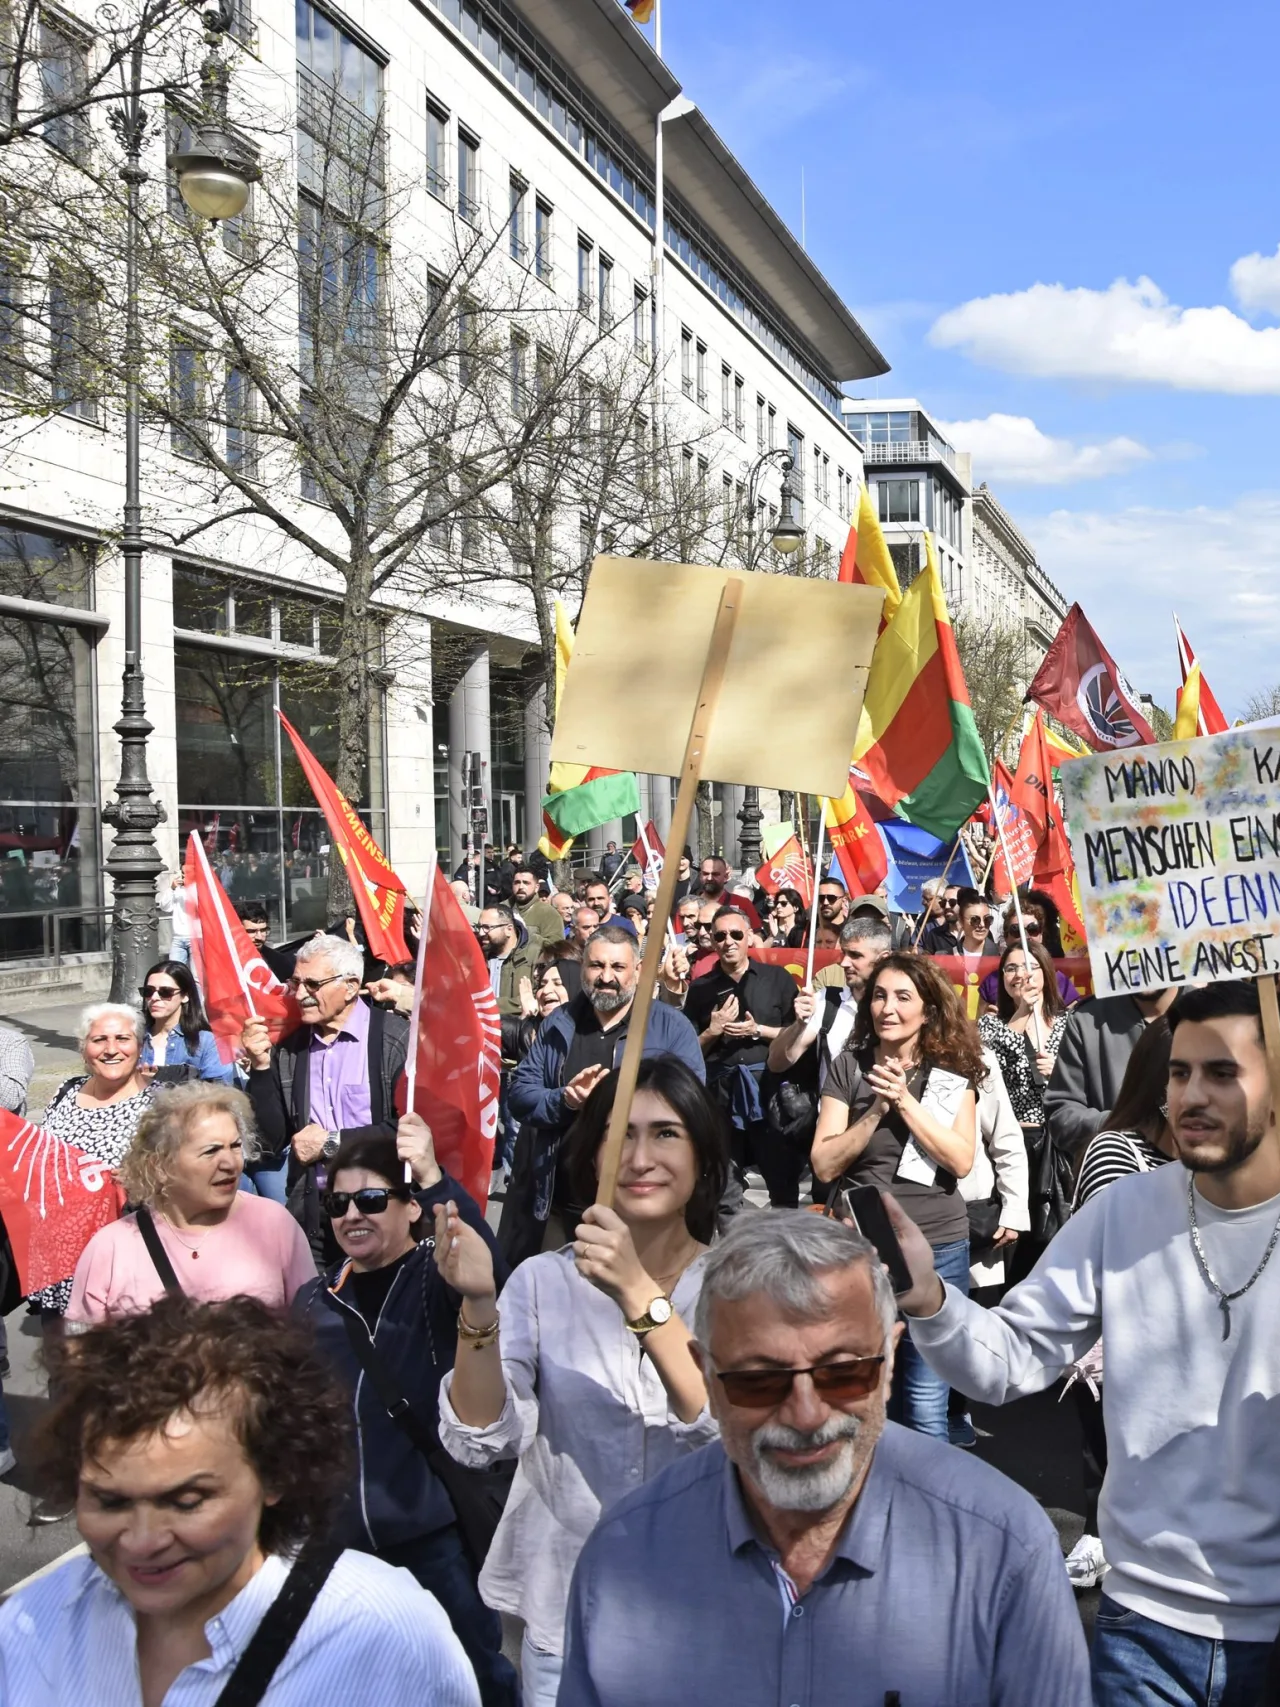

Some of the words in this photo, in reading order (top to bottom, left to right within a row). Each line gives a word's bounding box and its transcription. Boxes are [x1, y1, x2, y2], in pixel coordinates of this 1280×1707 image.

[1103, 755, 1196, 803] MAN(N)
[335, 789, 396, 873] EMEINSA
[1084, 820, 1216, 887] MENSCHEN
[1104, 944, 1187, 991] KEINE
[1193, 933, 1280, 977] ANGST,
